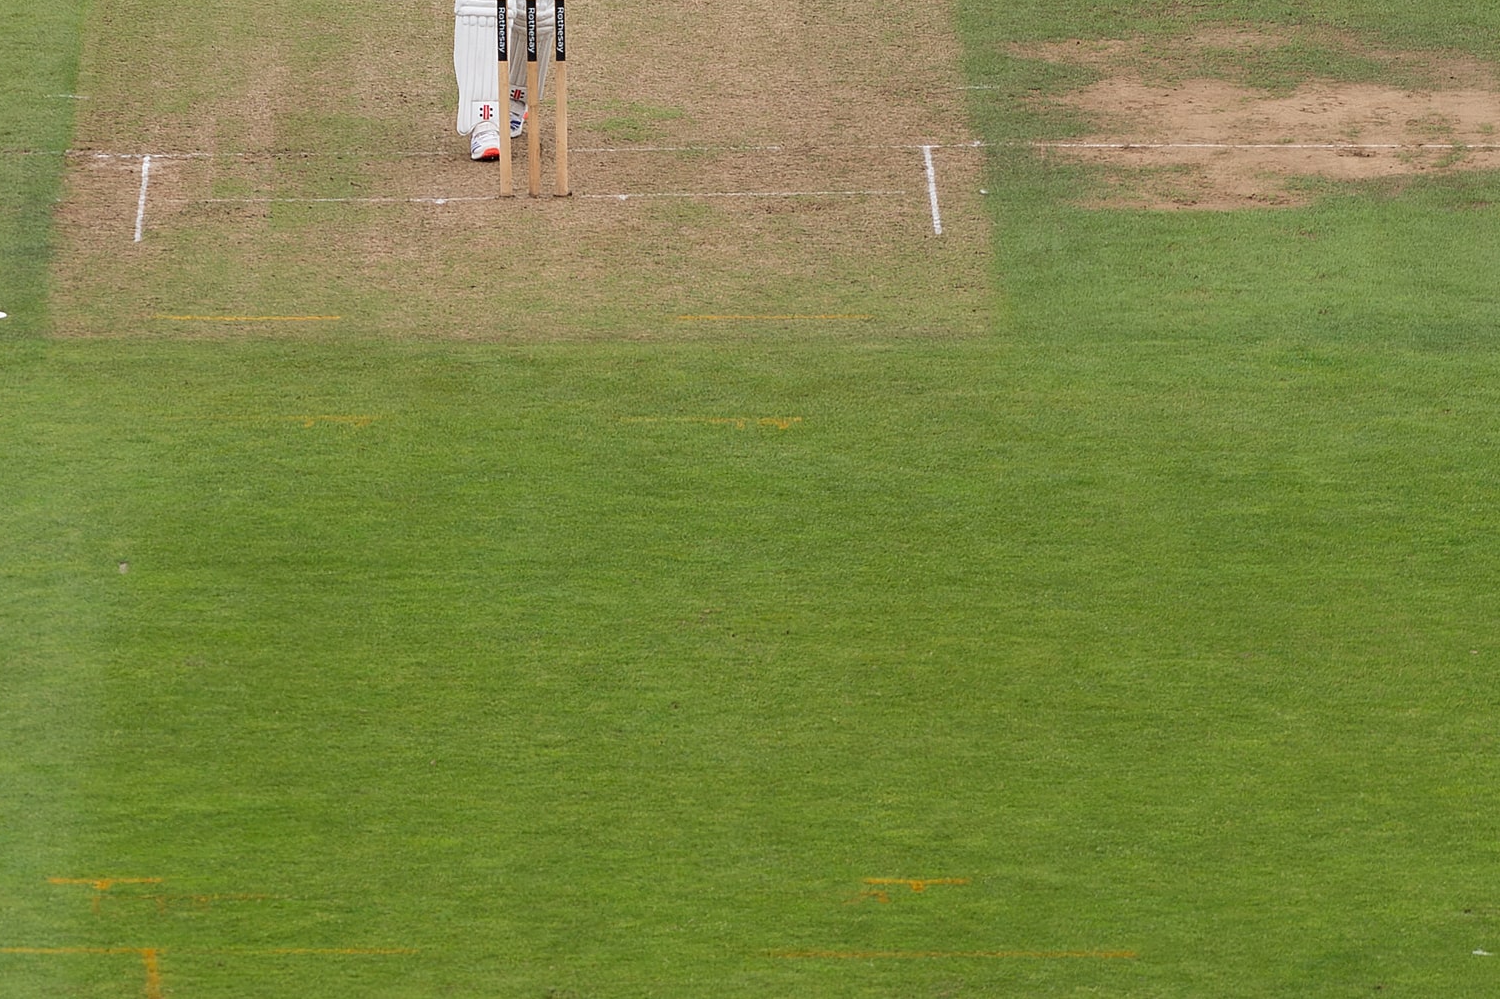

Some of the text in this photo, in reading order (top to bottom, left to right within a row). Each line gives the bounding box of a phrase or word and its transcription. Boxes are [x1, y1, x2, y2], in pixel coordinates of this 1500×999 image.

[498, 6, 506, 53] Rothesay
[527, 7, 535, 53] Rothesay
[556, 6, 564, 53] Rothesay
